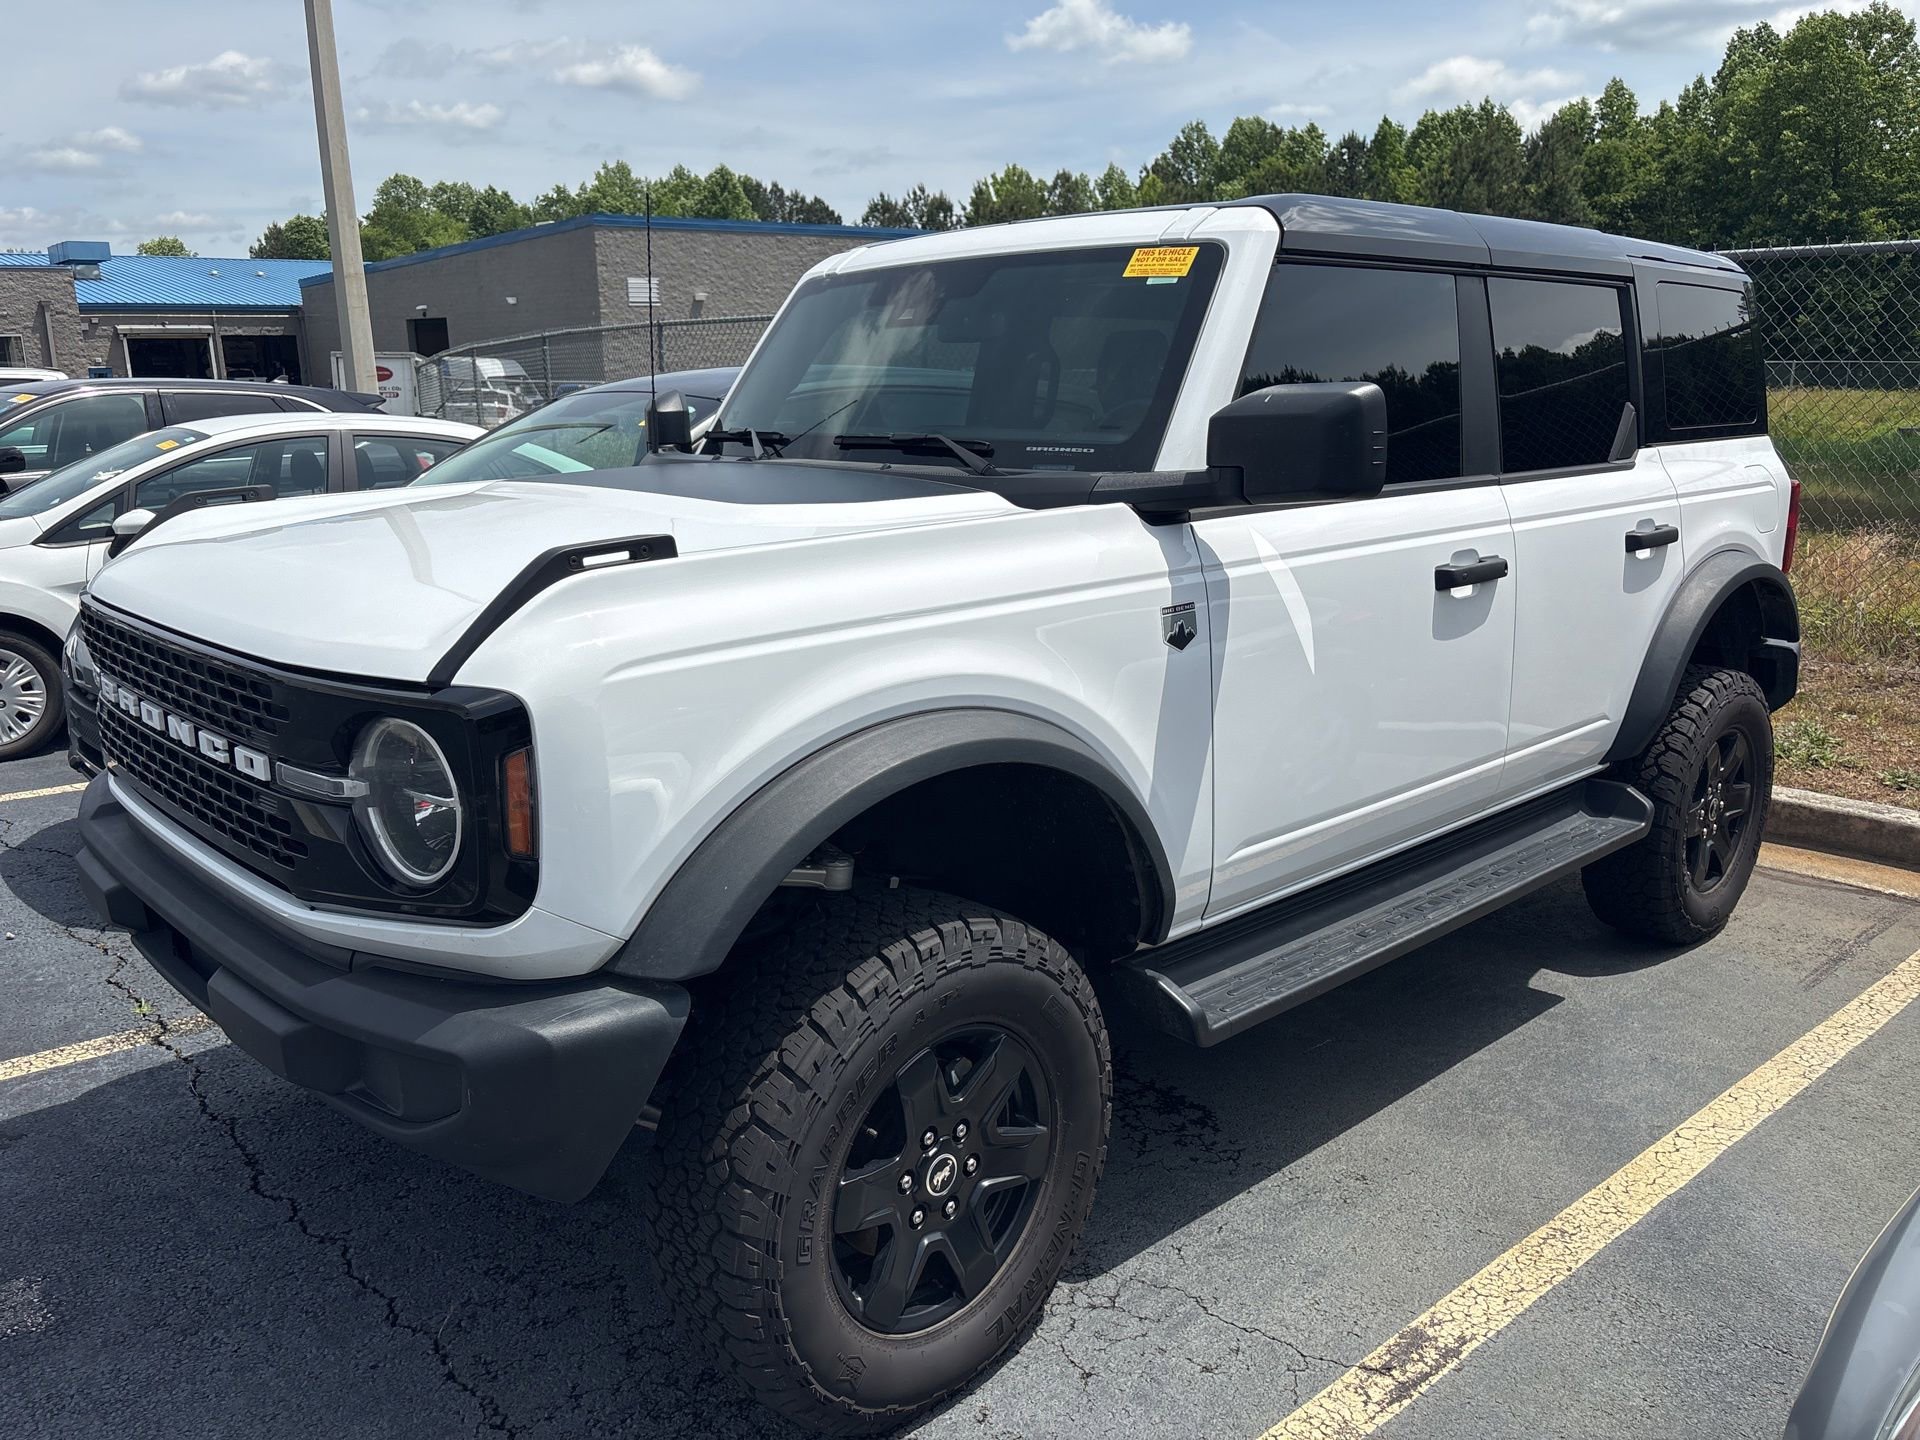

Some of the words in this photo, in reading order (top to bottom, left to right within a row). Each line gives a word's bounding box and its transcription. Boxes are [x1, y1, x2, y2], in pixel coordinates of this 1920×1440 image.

[1137, 249, 1156, 257] THIS
[1157, 248, 1194, 256] VEHICLE
[101, 673, 271, 782] BRONCO
[796, 1031, 899, 1267] GRABBER
[984, 1150, 1091, 1340] GENERAL
